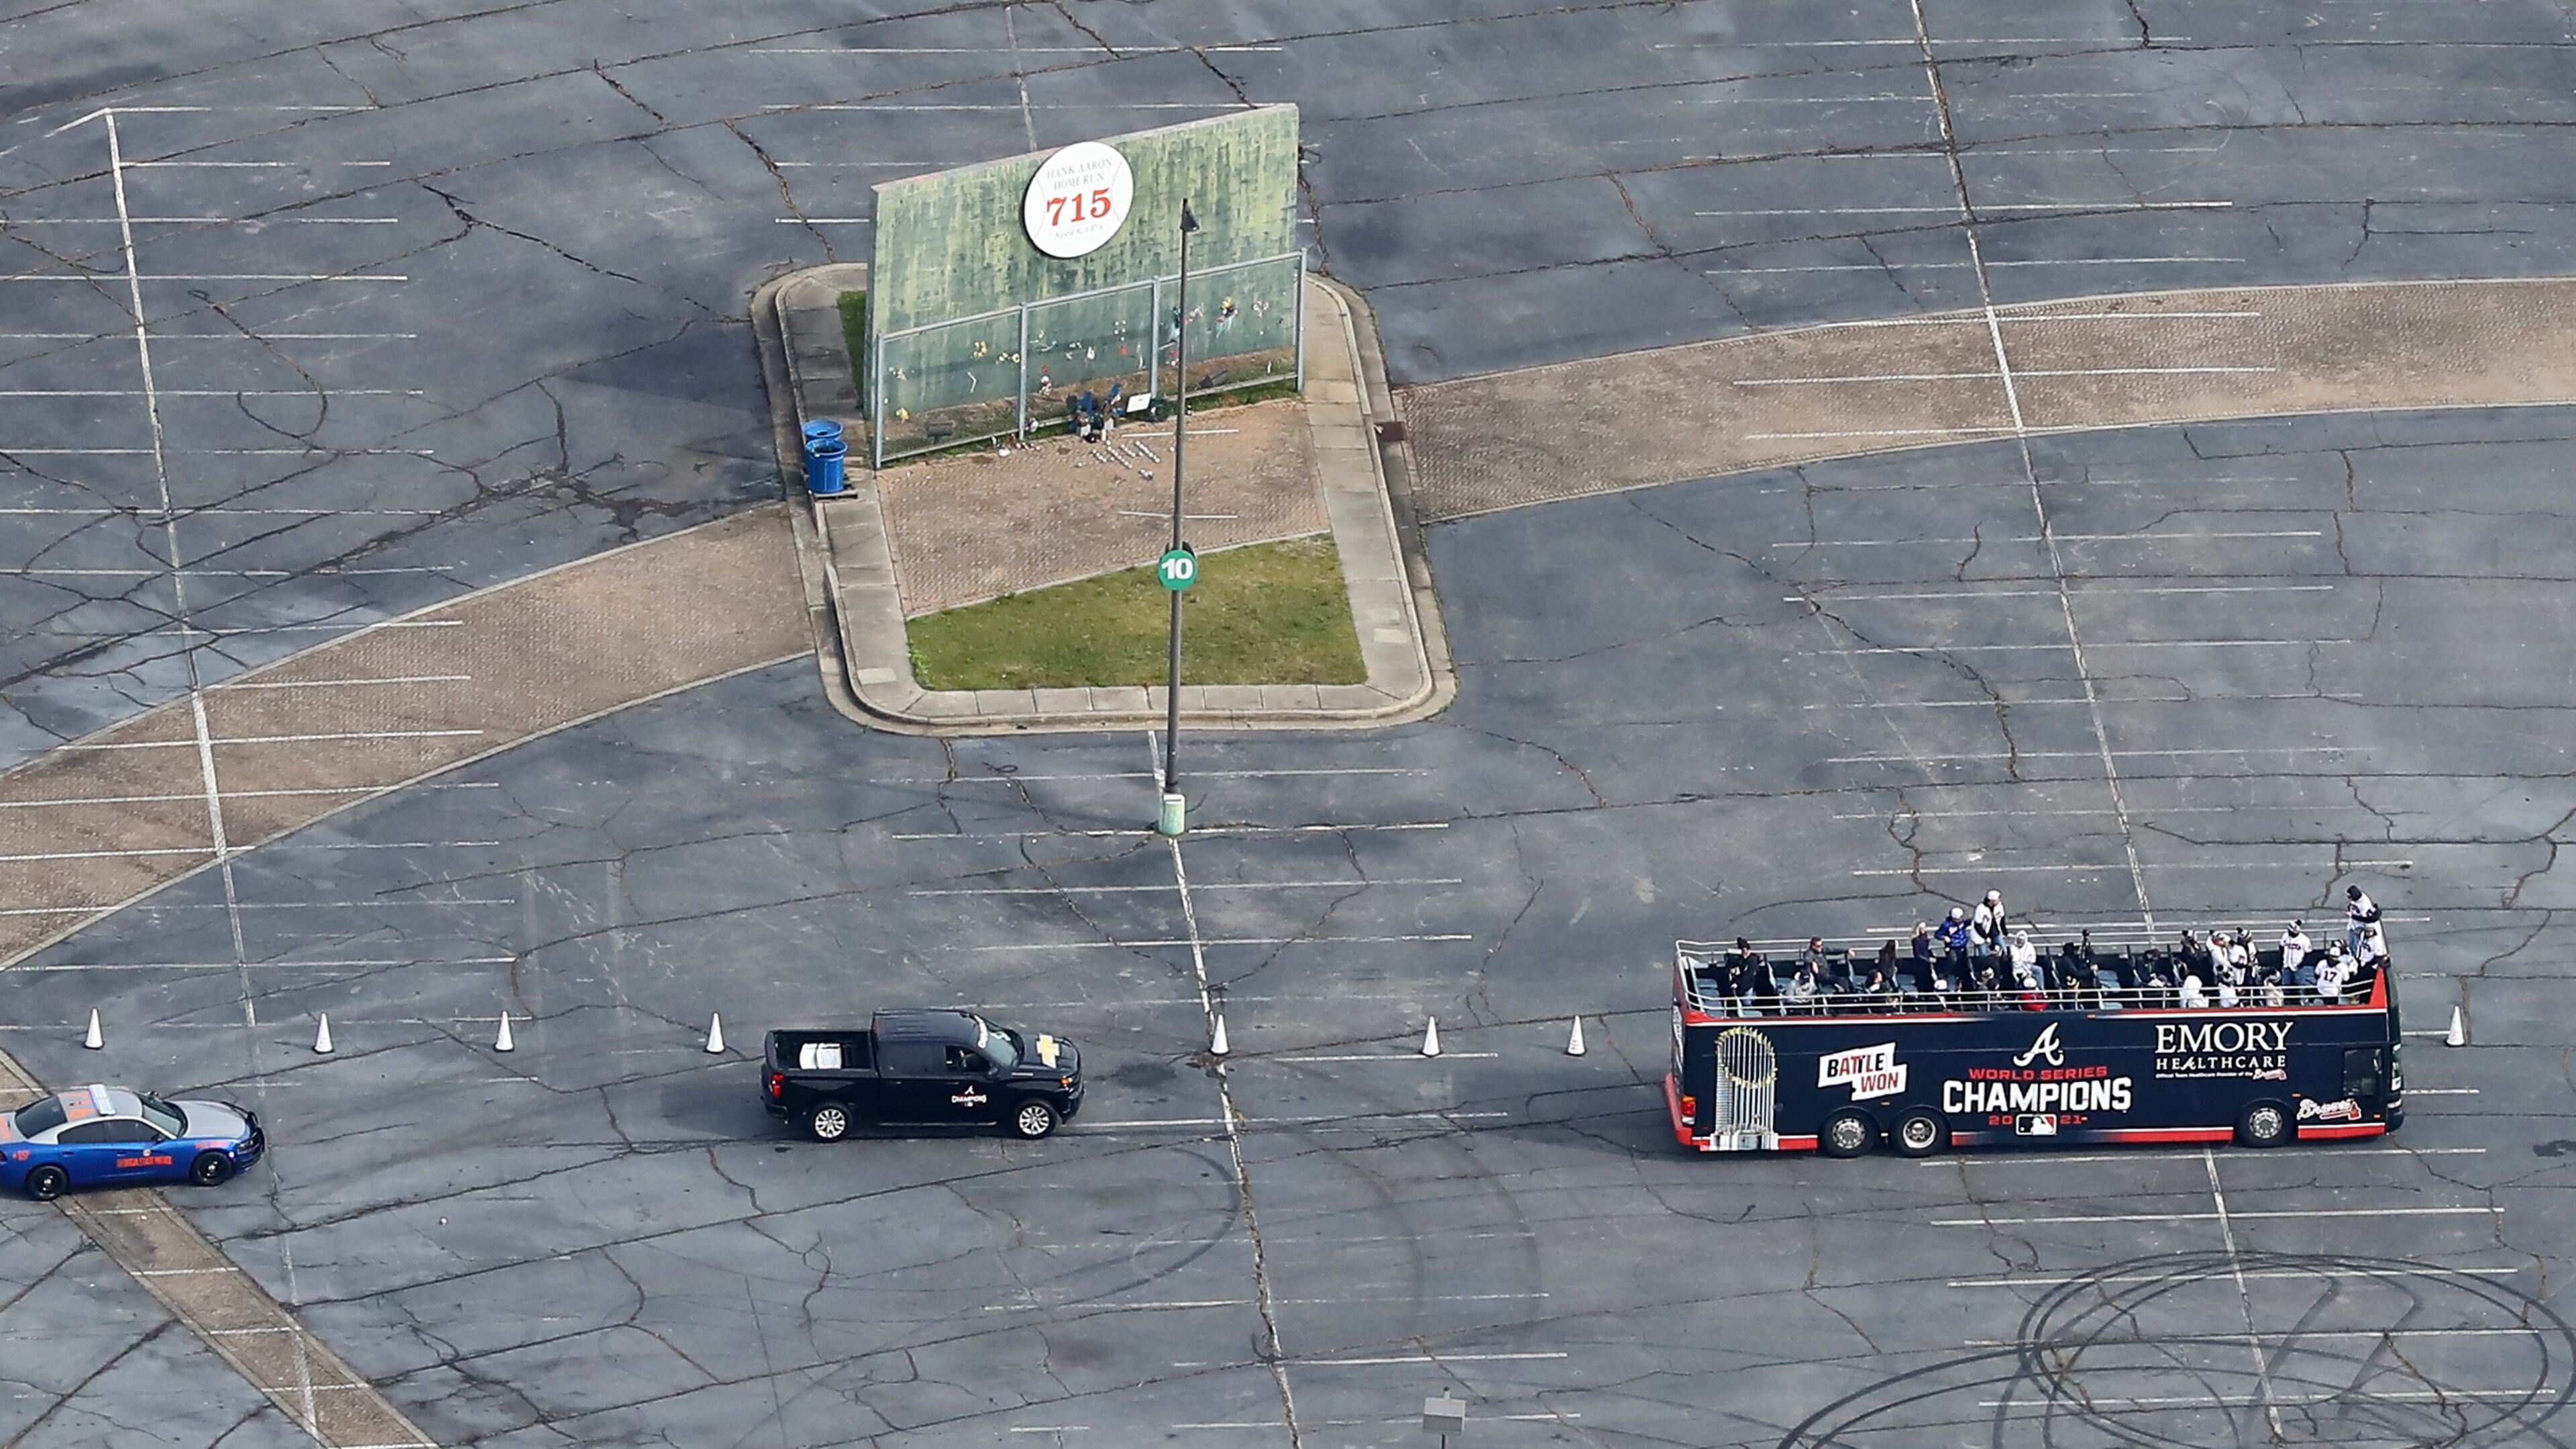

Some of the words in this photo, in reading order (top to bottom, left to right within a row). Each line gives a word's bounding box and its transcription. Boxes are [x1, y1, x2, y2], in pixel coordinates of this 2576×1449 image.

[1047, 165, 1075, 180] HANK
[1077, 157, 1113, 174] AARON
[1054, 176, 1081, 191] HOME
[1083, 172, 1106, 185] RUN
[1046, 187, 1112, 227] 715
[1161, 557, 1193, 580] 10
[2323, 970, 2338, 983] 17
[2013, 1022, 2064, 1067] A
[2154, 1022, 2294, 1053] EMORY
[1827, 1053, 1885, 1077] BATTLE
[1968, 1068, 2035, 1079] WORLD
[2040, 1066, 2108, 1079] SERIES
[2156, 1055, 2286, 1071] HEALTHCARE
[1861, 1072, 1898, 1093] WON
[1943, 1077, 2132, 1113] CHAMPIONS
